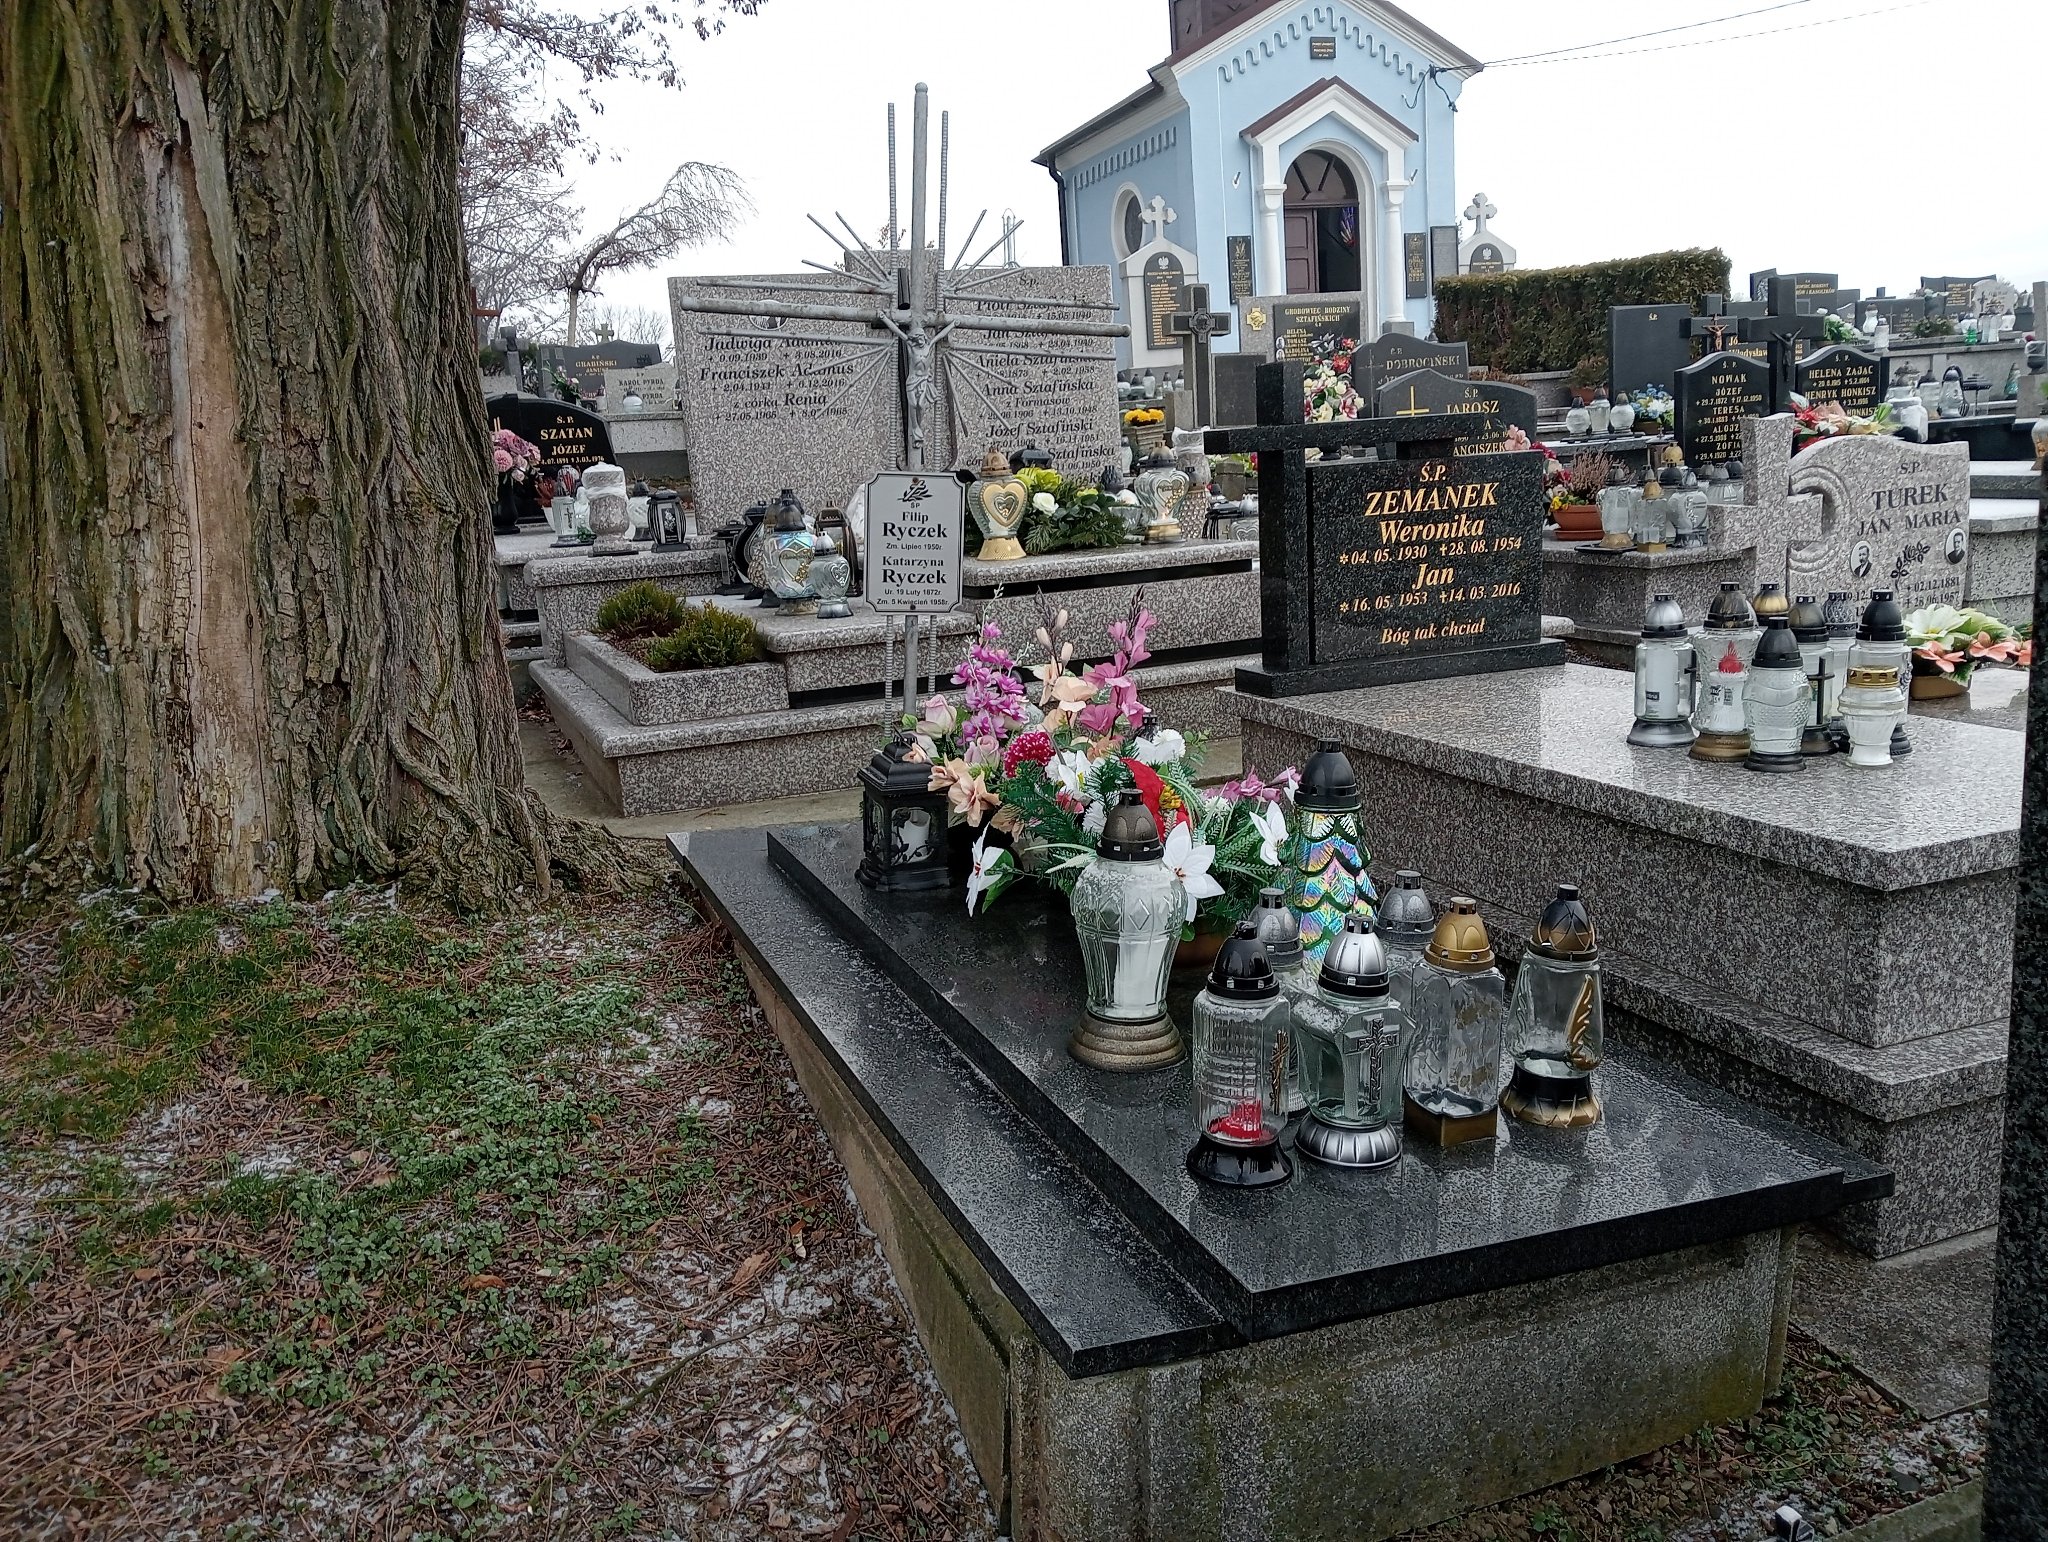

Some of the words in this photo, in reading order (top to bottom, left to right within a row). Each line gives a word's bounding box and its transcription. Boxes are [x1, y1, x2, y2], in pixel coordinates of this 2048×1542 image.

[705, 336, 772, 352] Jadwiga
[701, 364, 785, 381] Franciszek
[1711, 373, 1747, 385] NOWAK
[1808, 368, 1842, 379] HELENA
[982, 379, 1017, 396] Anna
[1715, 387, 1743, 396] JÓZEF
[1804, 389, 1838, 400] HENRYK
[1841, 386, 1877, 398] HONKISZ
[1712, 405, 1745, 415] TERESA
[540, 427, 594, 440] SZATAN
[551, 444, 586, 456] JÓZEF
[1453, 442, 1506, 457] ANCISZEK
[1364, 482, 1500, 516] ZEMANEK
[1872, 483, 1948, 511] TUREK
[902, 511, 929, 524] Filip
[1856, 518, 1891, 537] JAN
[1905, 510, 1961, 531] MARIA
[882, 522, 948, 541] Ryczek
[1378, 514, 1485, 544] Weronika
[901, 543, 921, 551] Lipiec
[1351, 550, 1370, 565] 04.
[1374, 548, 1393, 562] 05.
[1397, 545, 1428, 561] 1930
[1470, 540, 1489, 554] 08.
[1493, 536, 1522, 552] 1954
[882, 556, 944, 569] Katarzyna
[882, 568, 947, 587] Ryczek
[1411, 563, 1455, 590] Jan
[906, 589, 921, 597] Luty
[1375, 596, 1394, 610] 05.
[1398, 592, 1428, 607] 1953
[1469, 586, 1487, 600] 03.
[1490, 582, 1521, 598] 2016
[1380, 627, 1410, 646] Bóg
[1414, 622, 1437, 640] tak
[1441, 617, 1486, 636] chciał
